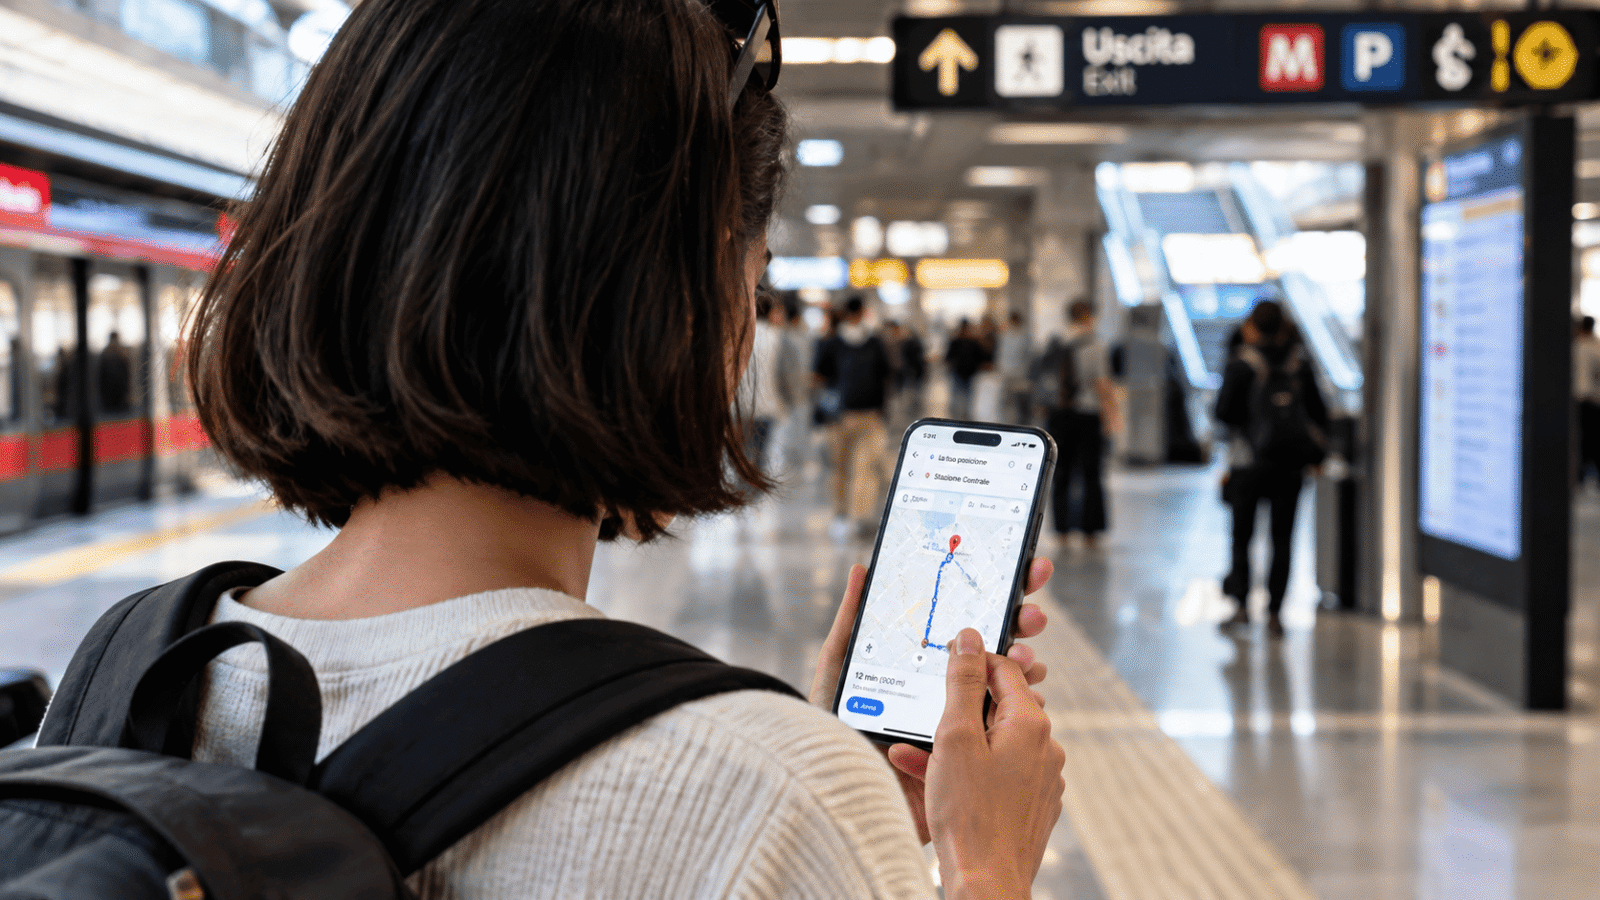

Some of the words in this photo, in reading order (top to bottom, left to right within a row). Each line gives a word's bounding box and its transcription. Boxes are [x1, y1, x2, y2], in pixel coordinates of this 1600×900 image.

[1082, 26, 1195, 66] Uscita
[1266, 33, 1318, 82] M
[1353, 31, 1393, 82] P
[1082, 65, 1136, 96] Exit
[855, 671, 864, 680] 12
[865, 674, 878, 682] min
